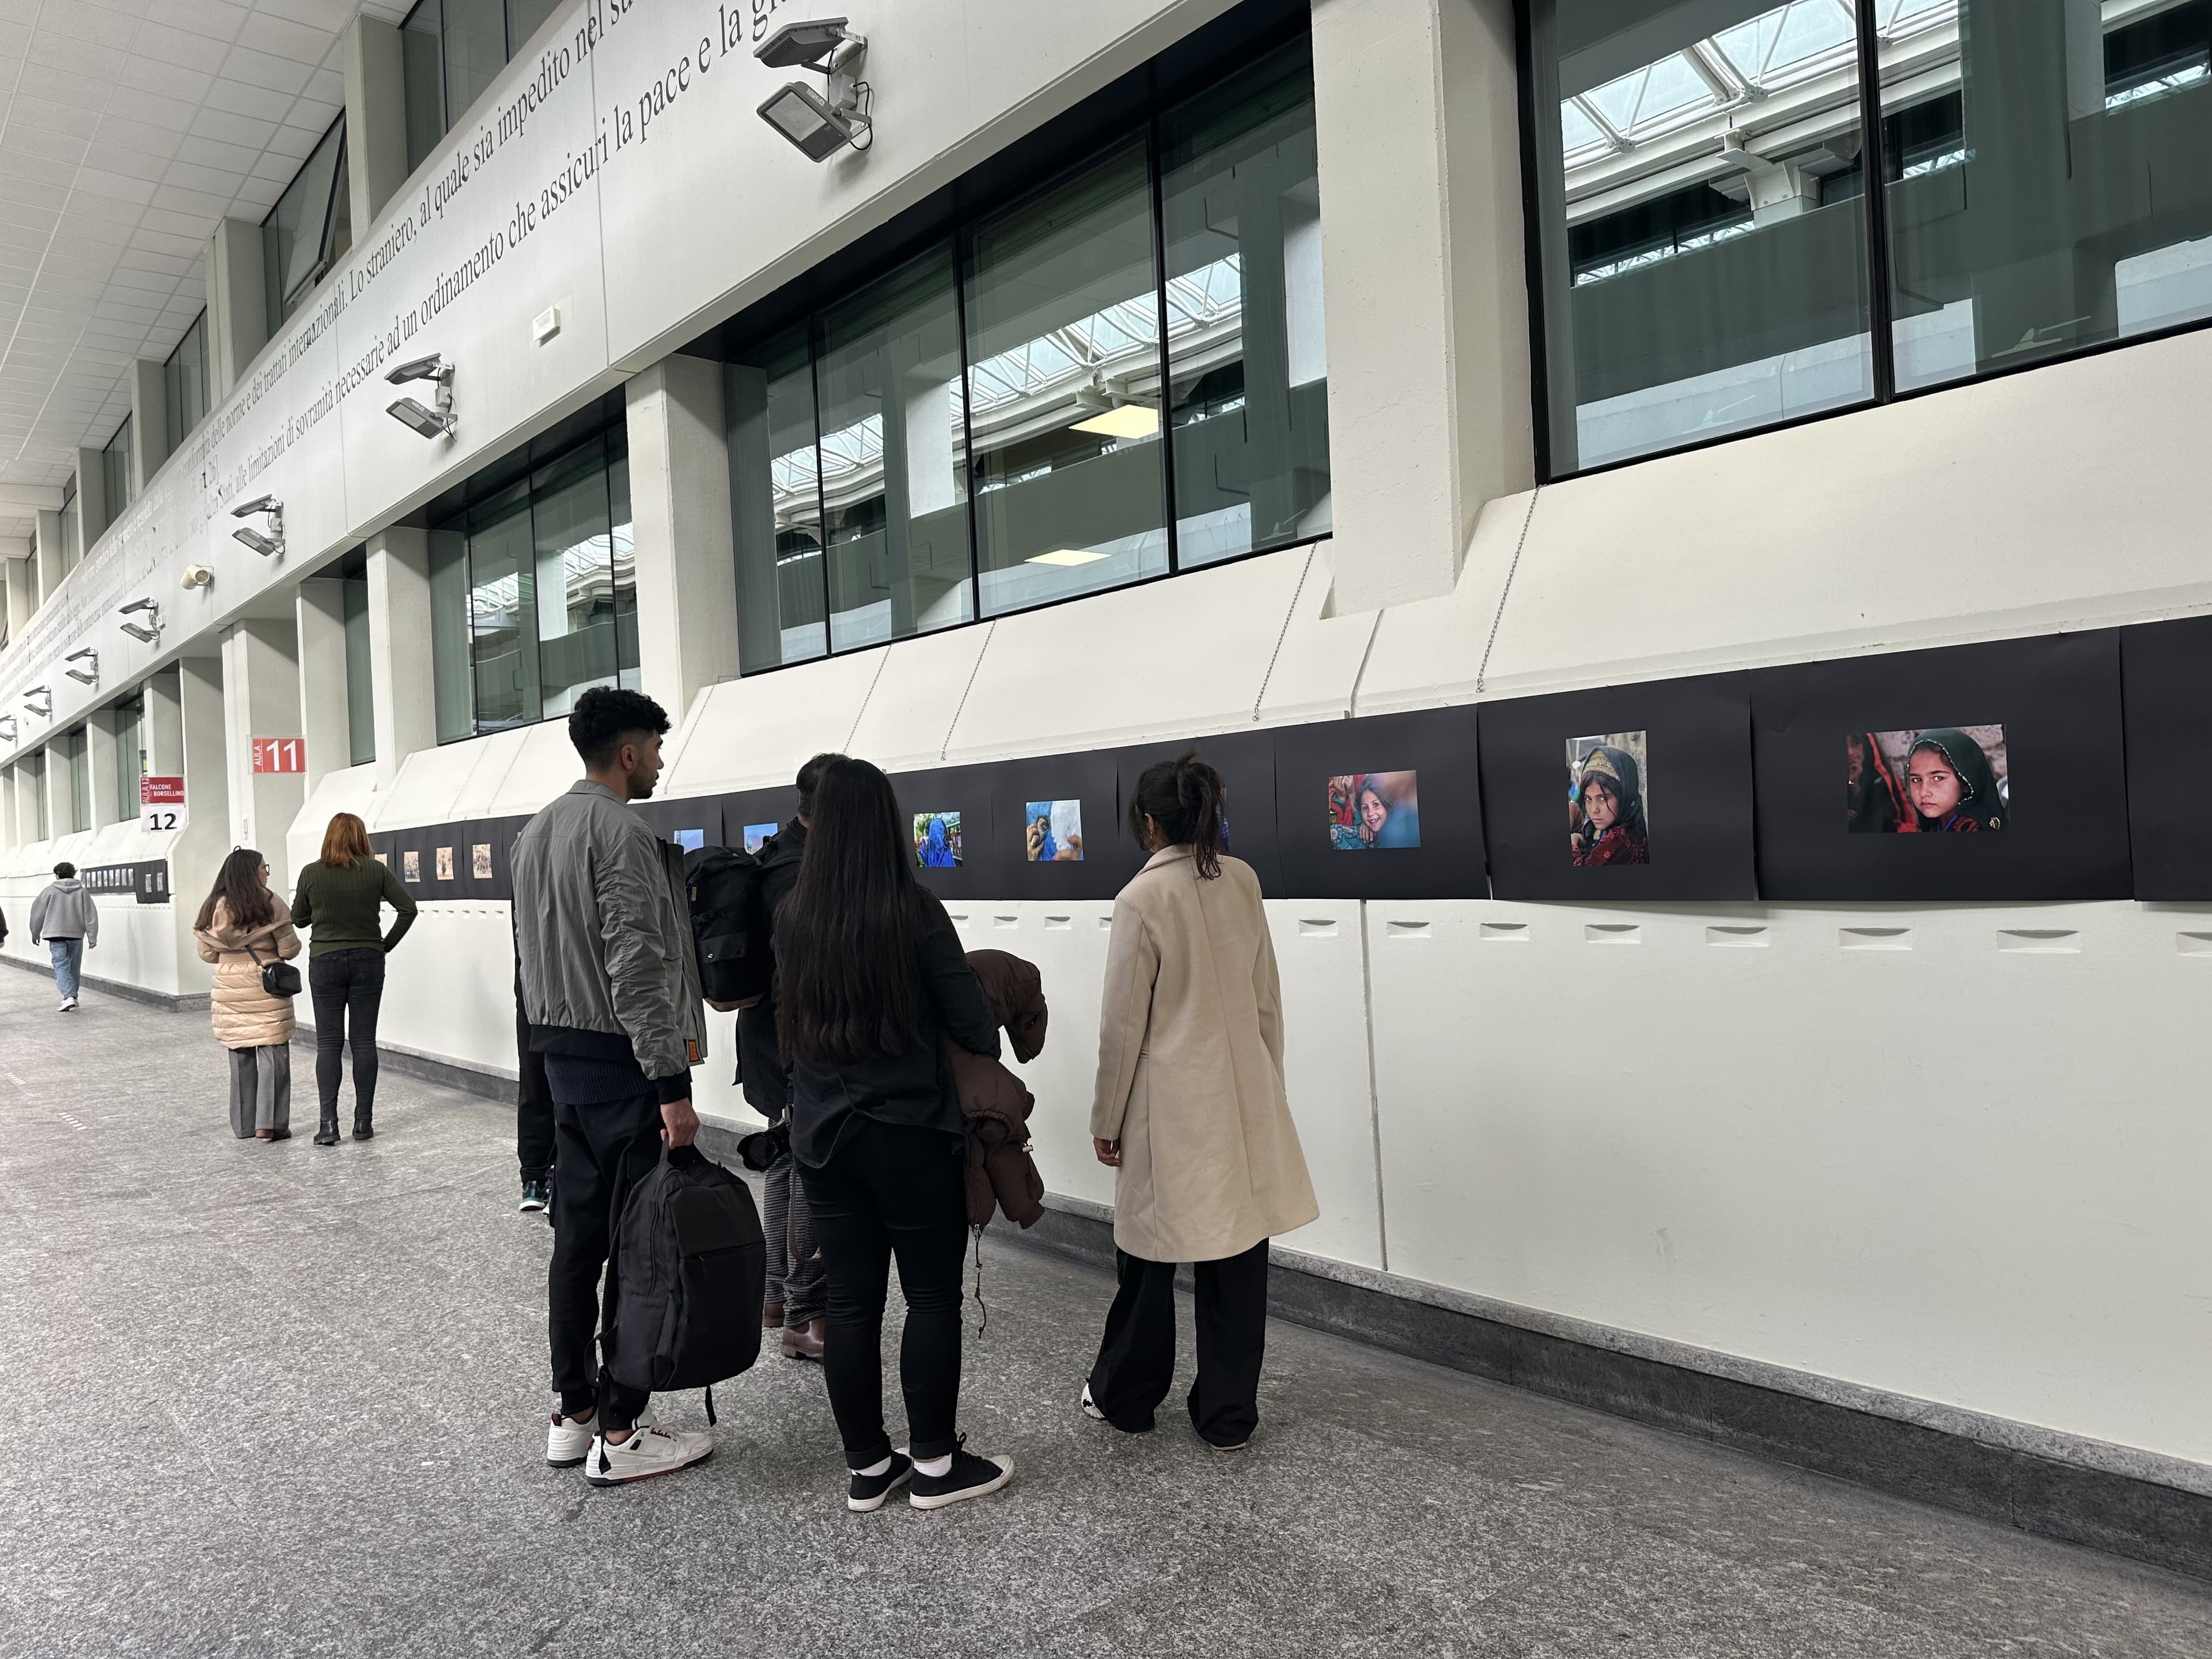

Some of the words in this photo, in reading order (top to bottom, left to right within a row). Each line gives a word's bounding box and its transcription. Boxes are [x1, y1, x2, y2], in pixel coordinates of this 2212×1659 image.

[211, 419, 225, 448] delle
[226, 397, 245, 434] norme
[247, 392, 251, 410] e
[252, 372, 263, 405] dei
[263, 345, 287, 392] trattati
[289, 280, 348, 368] internazionali.
[350, 268, 363, 302] Lo
[367, 217, 417, 285] straniero,
[421, 185, 432, 229] al
[435, 150, 470, 220] quale
[474, 125, 494, 172] sia
[498, 47, 569, 147] impedito
[575, 0, 604, 65] nel
[236, 462, 247, 494] alle
[248, 425, 285, 483] limitazioni
[287, 416, 294, 448] di
[296, 381, 334, 440] sovranità
[335, 335, 385, 406] necessarie
[387, 315, 400, 356] ad
[403, 309, 418, 342] un
[421, 232, 504, 326] ordinamento
[509, 201, 536, 249] che
[541, 117, 609, 219] assicuri
[615, 104, 634, 152] la
[639, 56, 691, 144] pace
[699, 36, 711, 73] e
[718, 3, 743, 57] la
[266, 740, 297, 771] 11
[142, 786, 150, 803] AULA
[150, 813, 177, 831] 12
